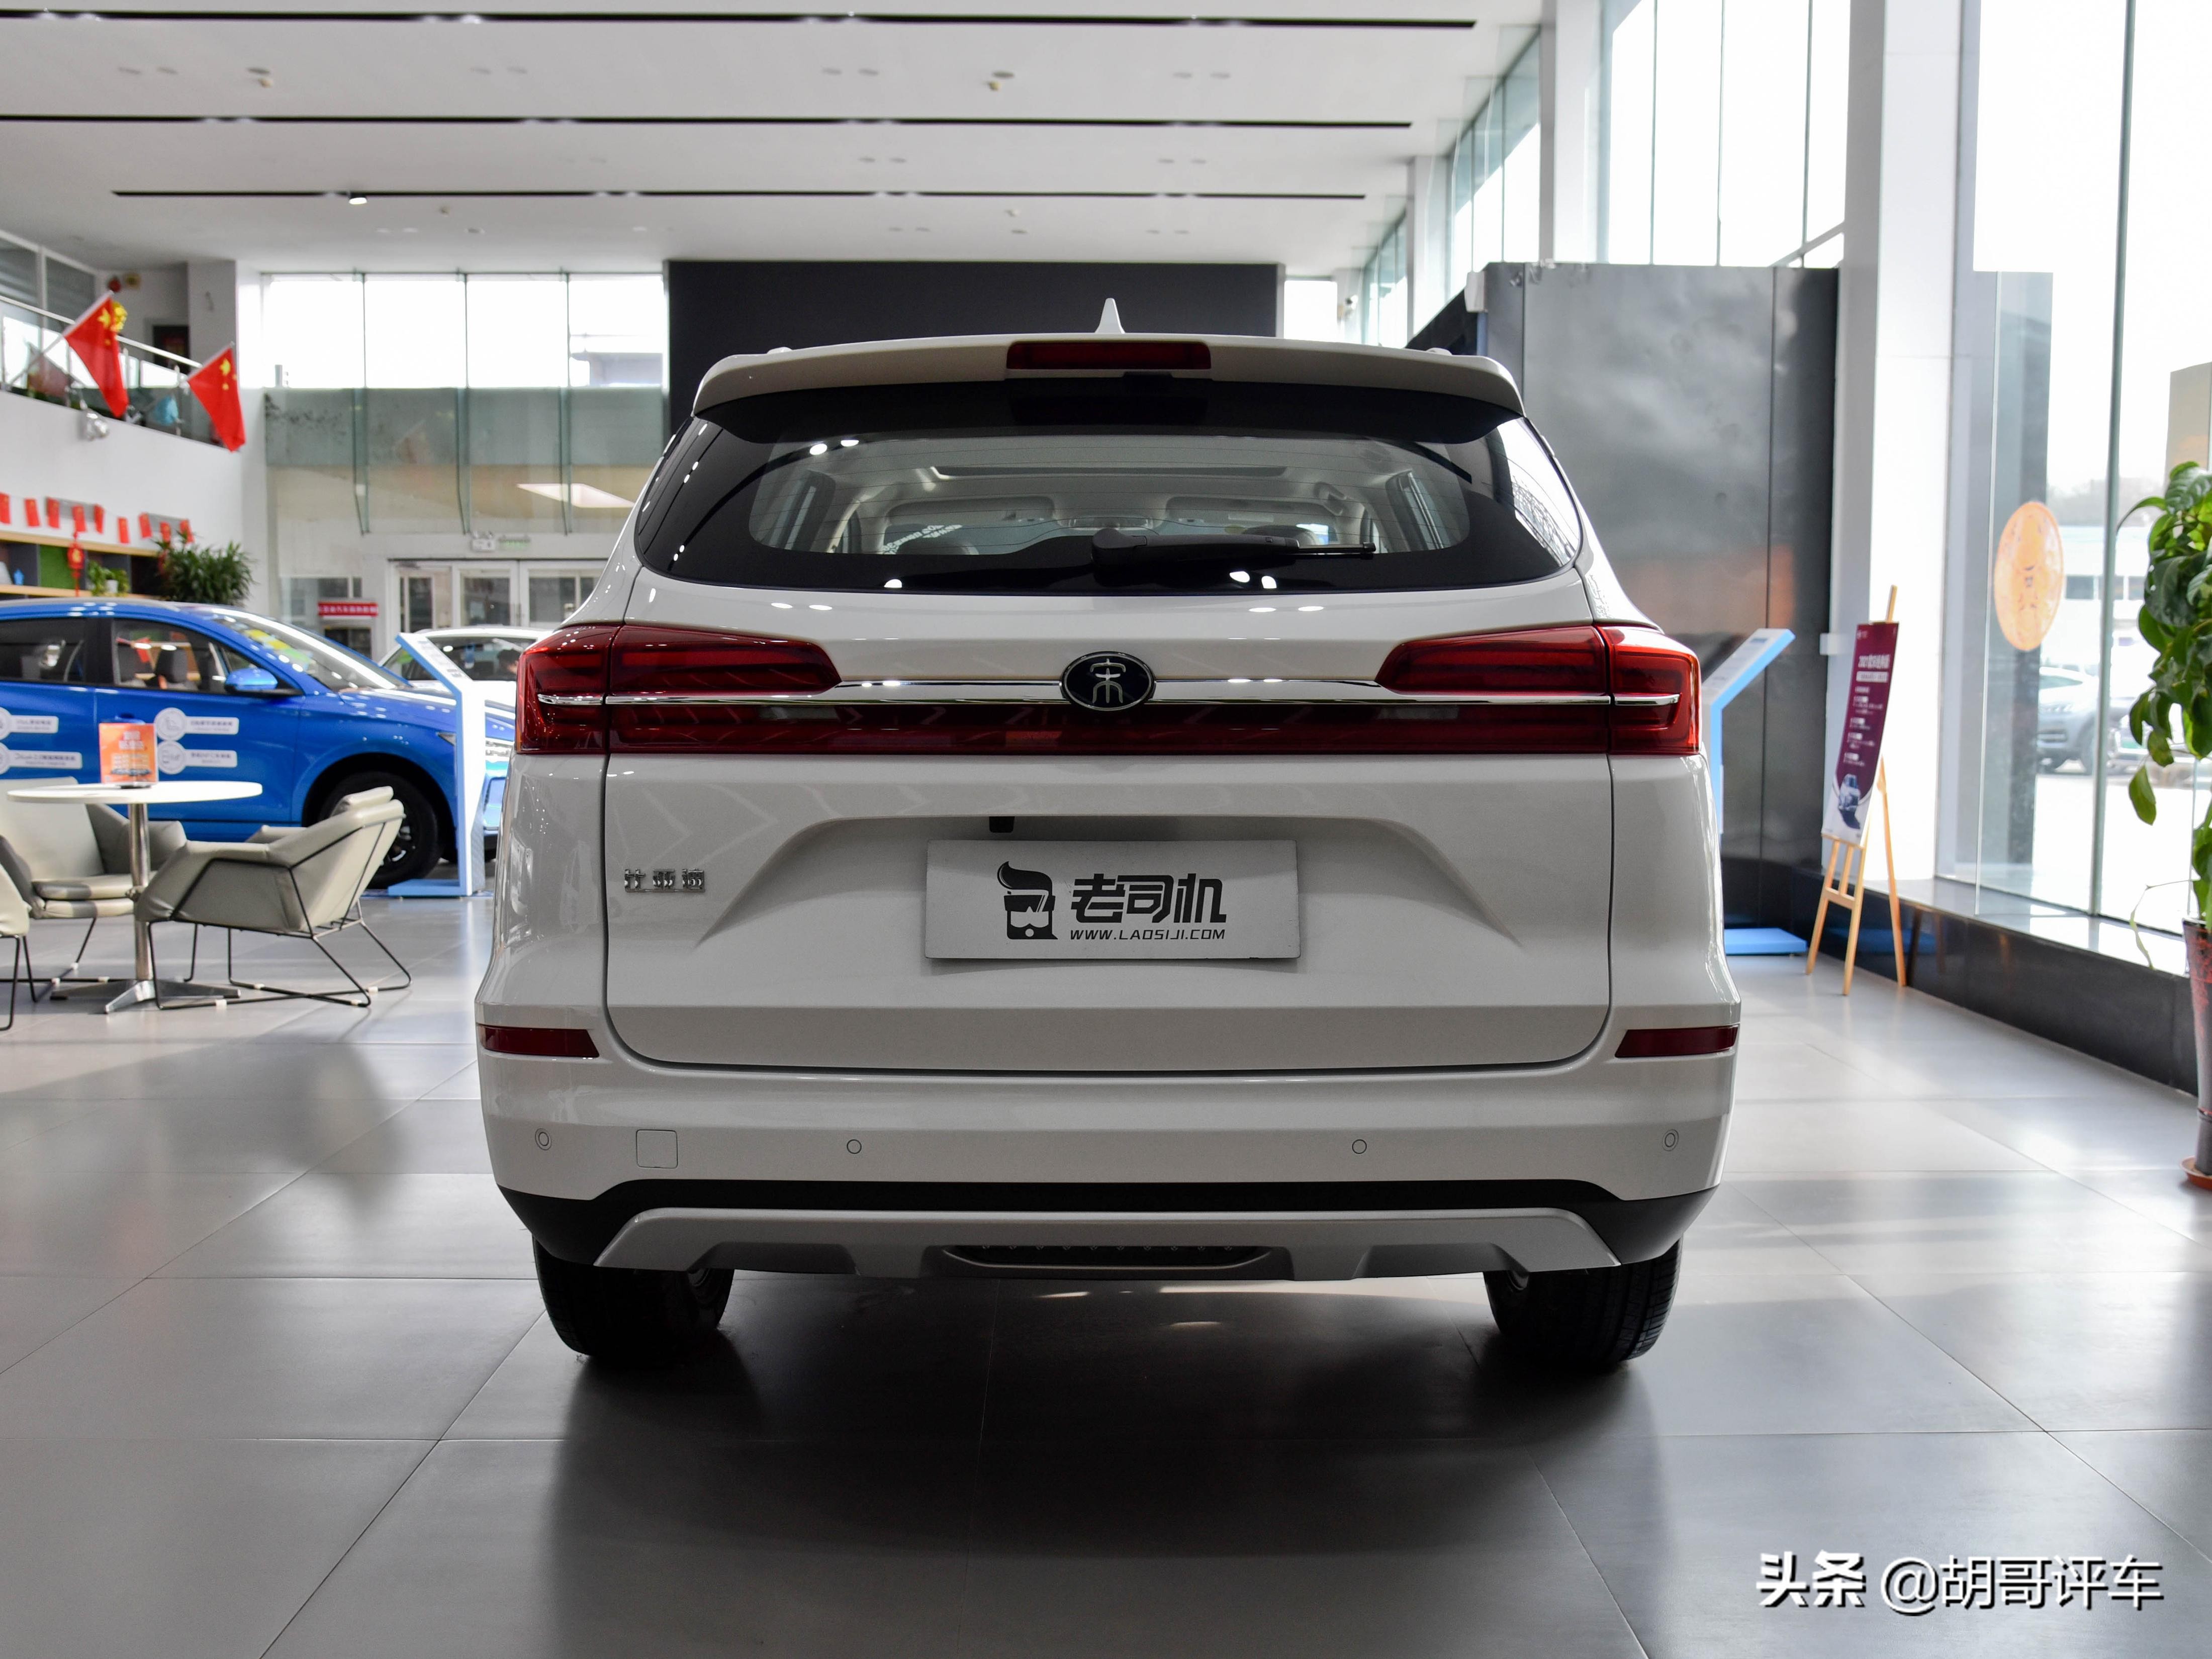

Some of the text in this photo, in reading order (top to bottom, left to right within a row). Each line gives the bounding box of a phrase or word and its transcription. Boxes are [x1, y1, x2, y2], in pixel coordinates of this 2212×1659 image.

[1071, 873, 1227, 923] 老司机
[1070, 930, 1225, 940] WWW.LAOSIJI.COM
